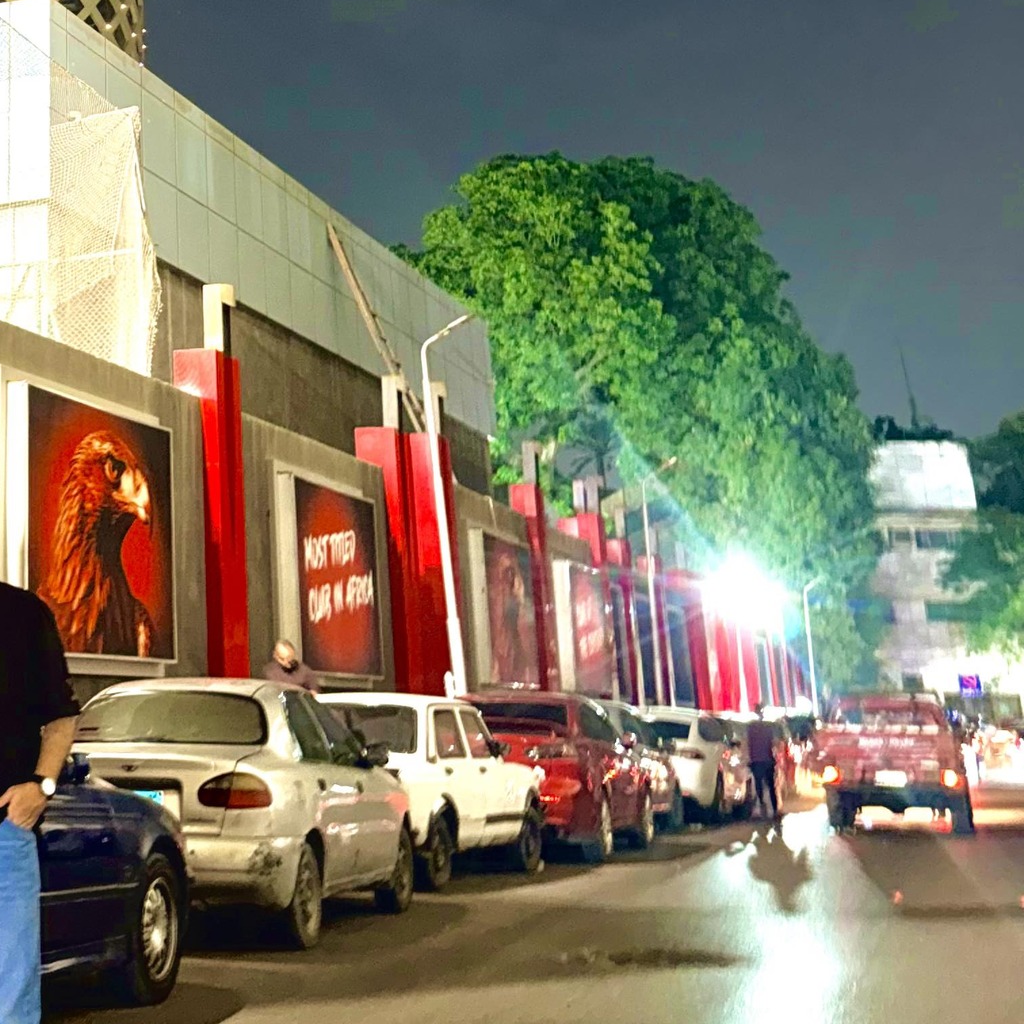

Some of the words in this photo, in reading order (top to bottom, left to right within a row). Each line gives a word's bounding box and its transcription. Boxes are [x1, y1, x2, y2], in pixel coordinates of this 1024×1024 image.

[304, 533, 329, 572] MOST
[309, 582, 332, 624] CLUB
[346, 570, 374, 613] AFRICA
